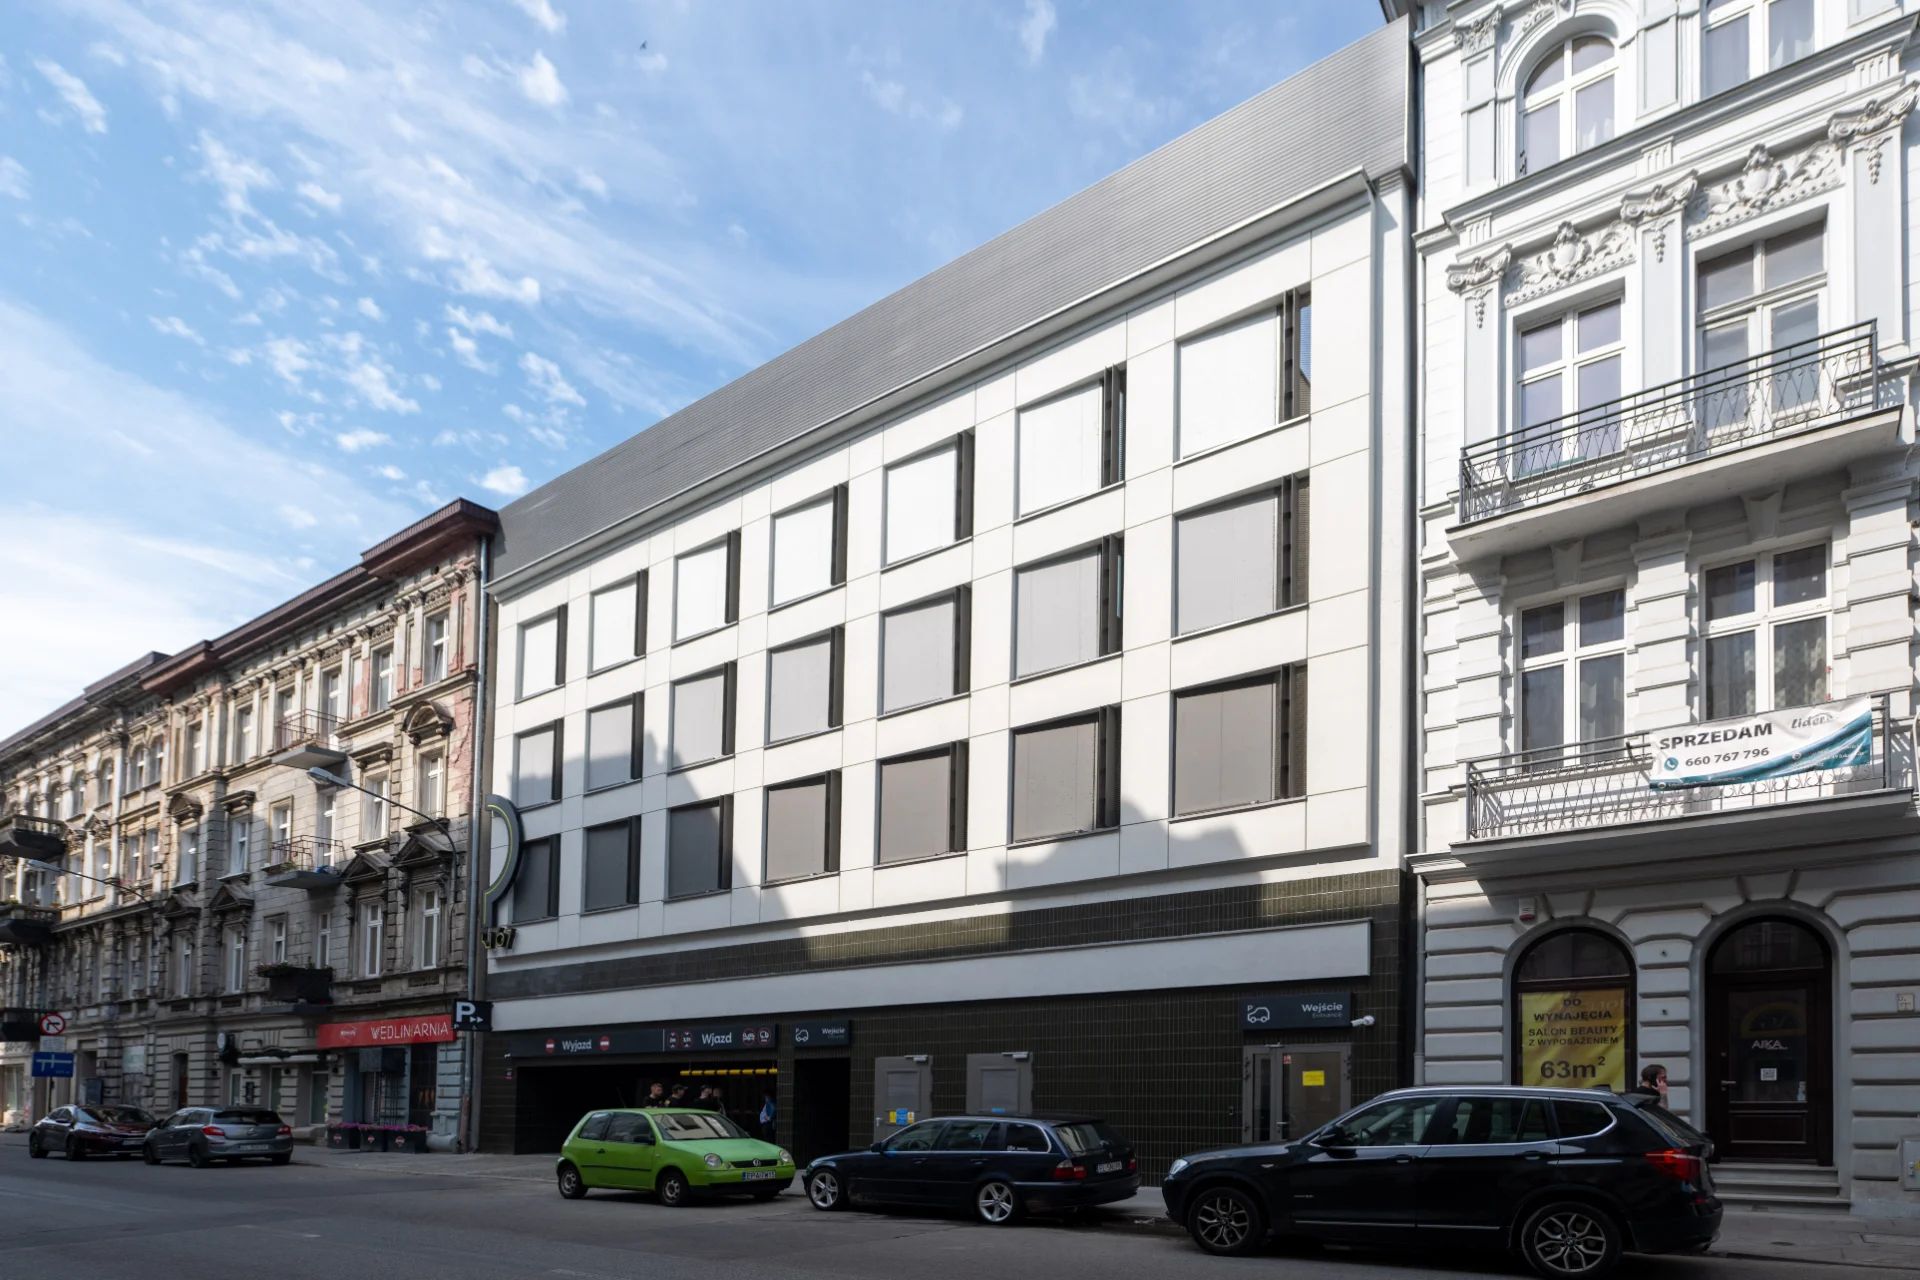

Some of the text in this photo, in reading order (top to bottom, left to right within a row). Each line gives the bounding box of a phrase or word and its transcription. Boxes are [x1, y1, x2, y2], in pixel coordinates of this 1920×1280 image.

[1659, 722, 1773, 749] SPRZEDAM
[1685, 747, 1770, 767] 660 767 796
[1301, 1002, 1343, 1013] Wejście
[1563, 998, 1582, 1007] DO
[456, 1001, 476, 1023] P
[1528, 1025, 1618, 1037] SALON BEAUTY
[561, 1038, 592, 1053] Wyjazd
[701, 1032, 732, 1047] Wjazd
